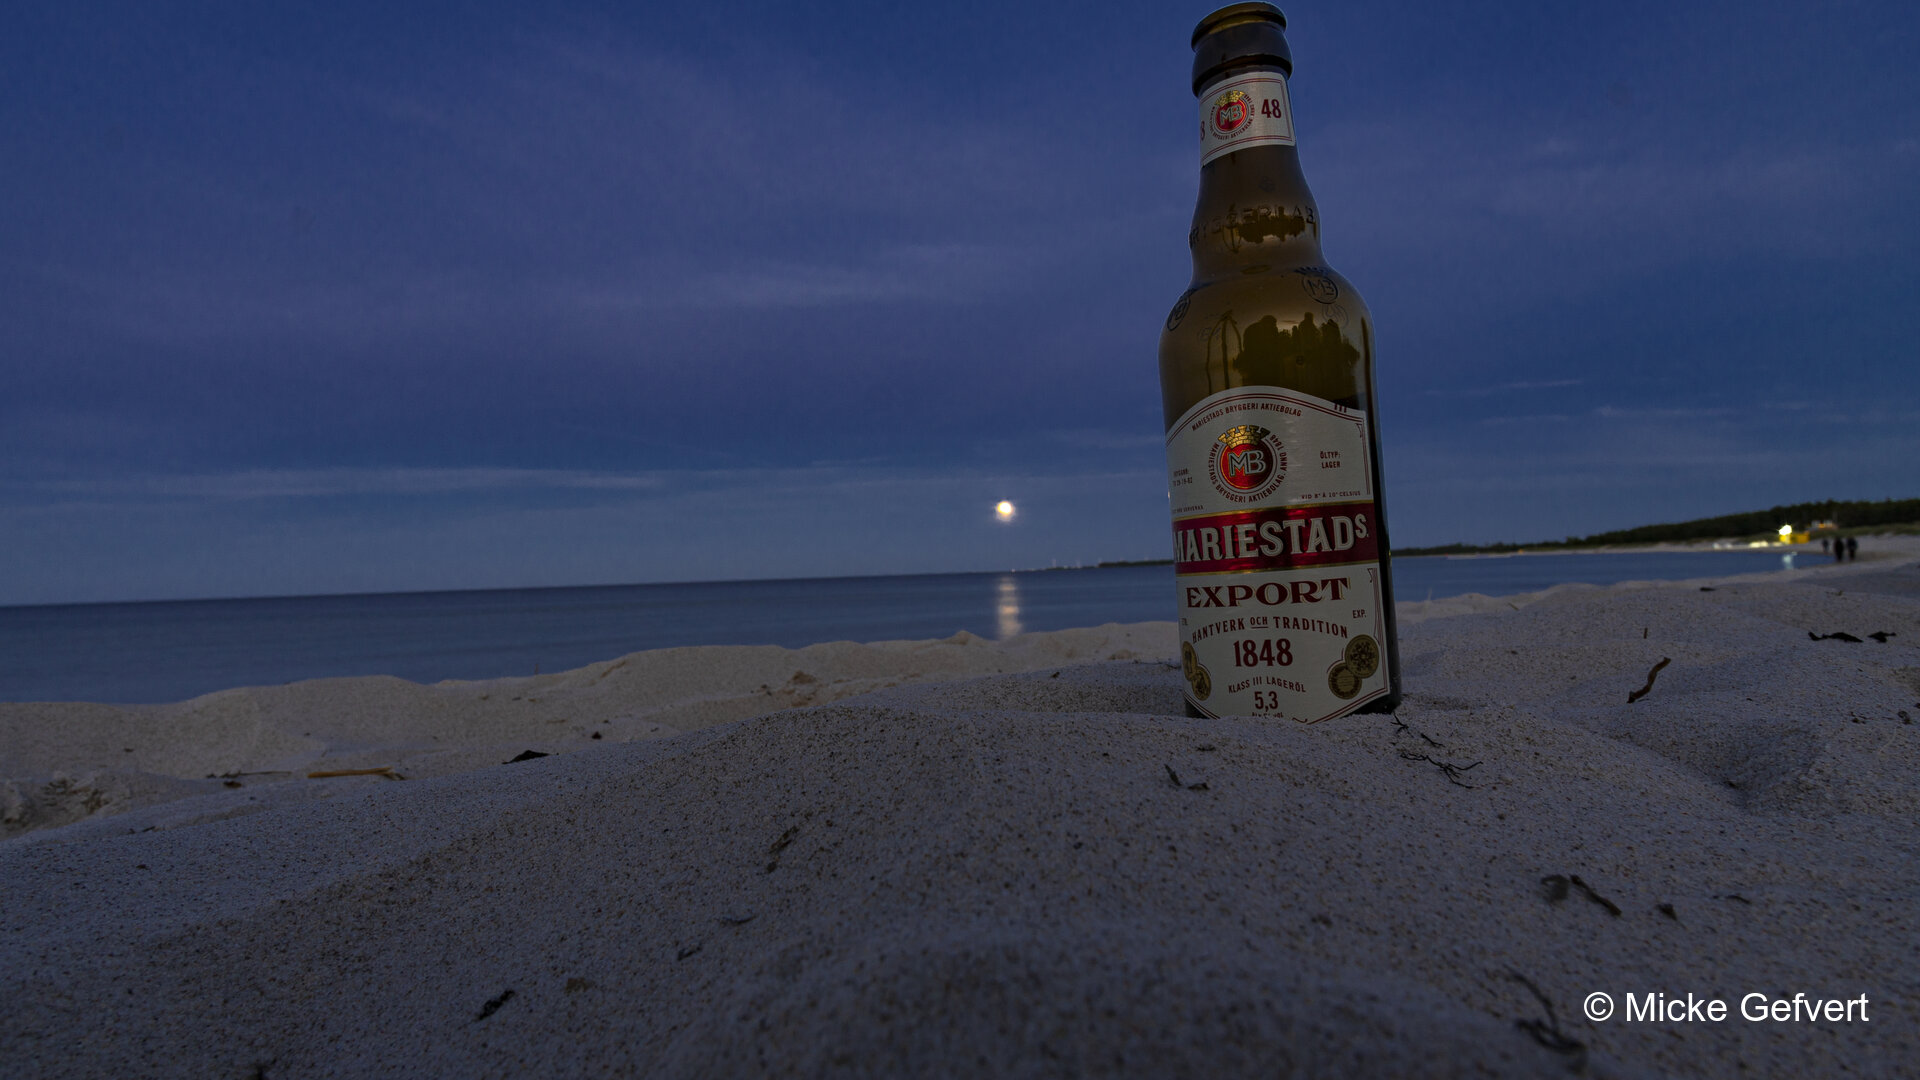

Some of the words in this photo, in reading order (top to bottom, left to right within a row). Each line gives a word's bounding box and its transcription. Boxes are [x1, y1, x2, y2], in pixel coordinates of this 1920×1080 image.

[1220, 105, 1242, 125] MB
[1261, 99, 1282, 118] 48
[1191, 409, 1224, 431] MARIESTADS
[1225, 403, 1259, 414] BRYGGERI
[1260, 402, 1302, 417] AKTIEBOLAG
[1269, 434, 1284, 451] 1848
[1208, 442, 1220, 485] MARIESTADS
[1228, 450, 1267, 477] MB
[1279, 452, 1287, 471] ANNO
[1321, 461, 1341, 469] LAGER
[1215, 484, 1246, 503] BRYGGERI
[1186, 577, 1351, 608] EXPORT
[1352, 609, 1367, 619] EXP.
[1192, 618, 1245, 644] HANTVERK
[1250, 616, 1268, 626] OCH
[1273, 616, 1348, 639] TRADITION
[1233, 638, 1293, 667] 1848
[1228, 679, 1250, 694] KLASS
[1252, 676, 1262, 686] III
[1266, 676, 1306, 692] LAGERÖL
[1254, 691, 1279, 712] 5,3
